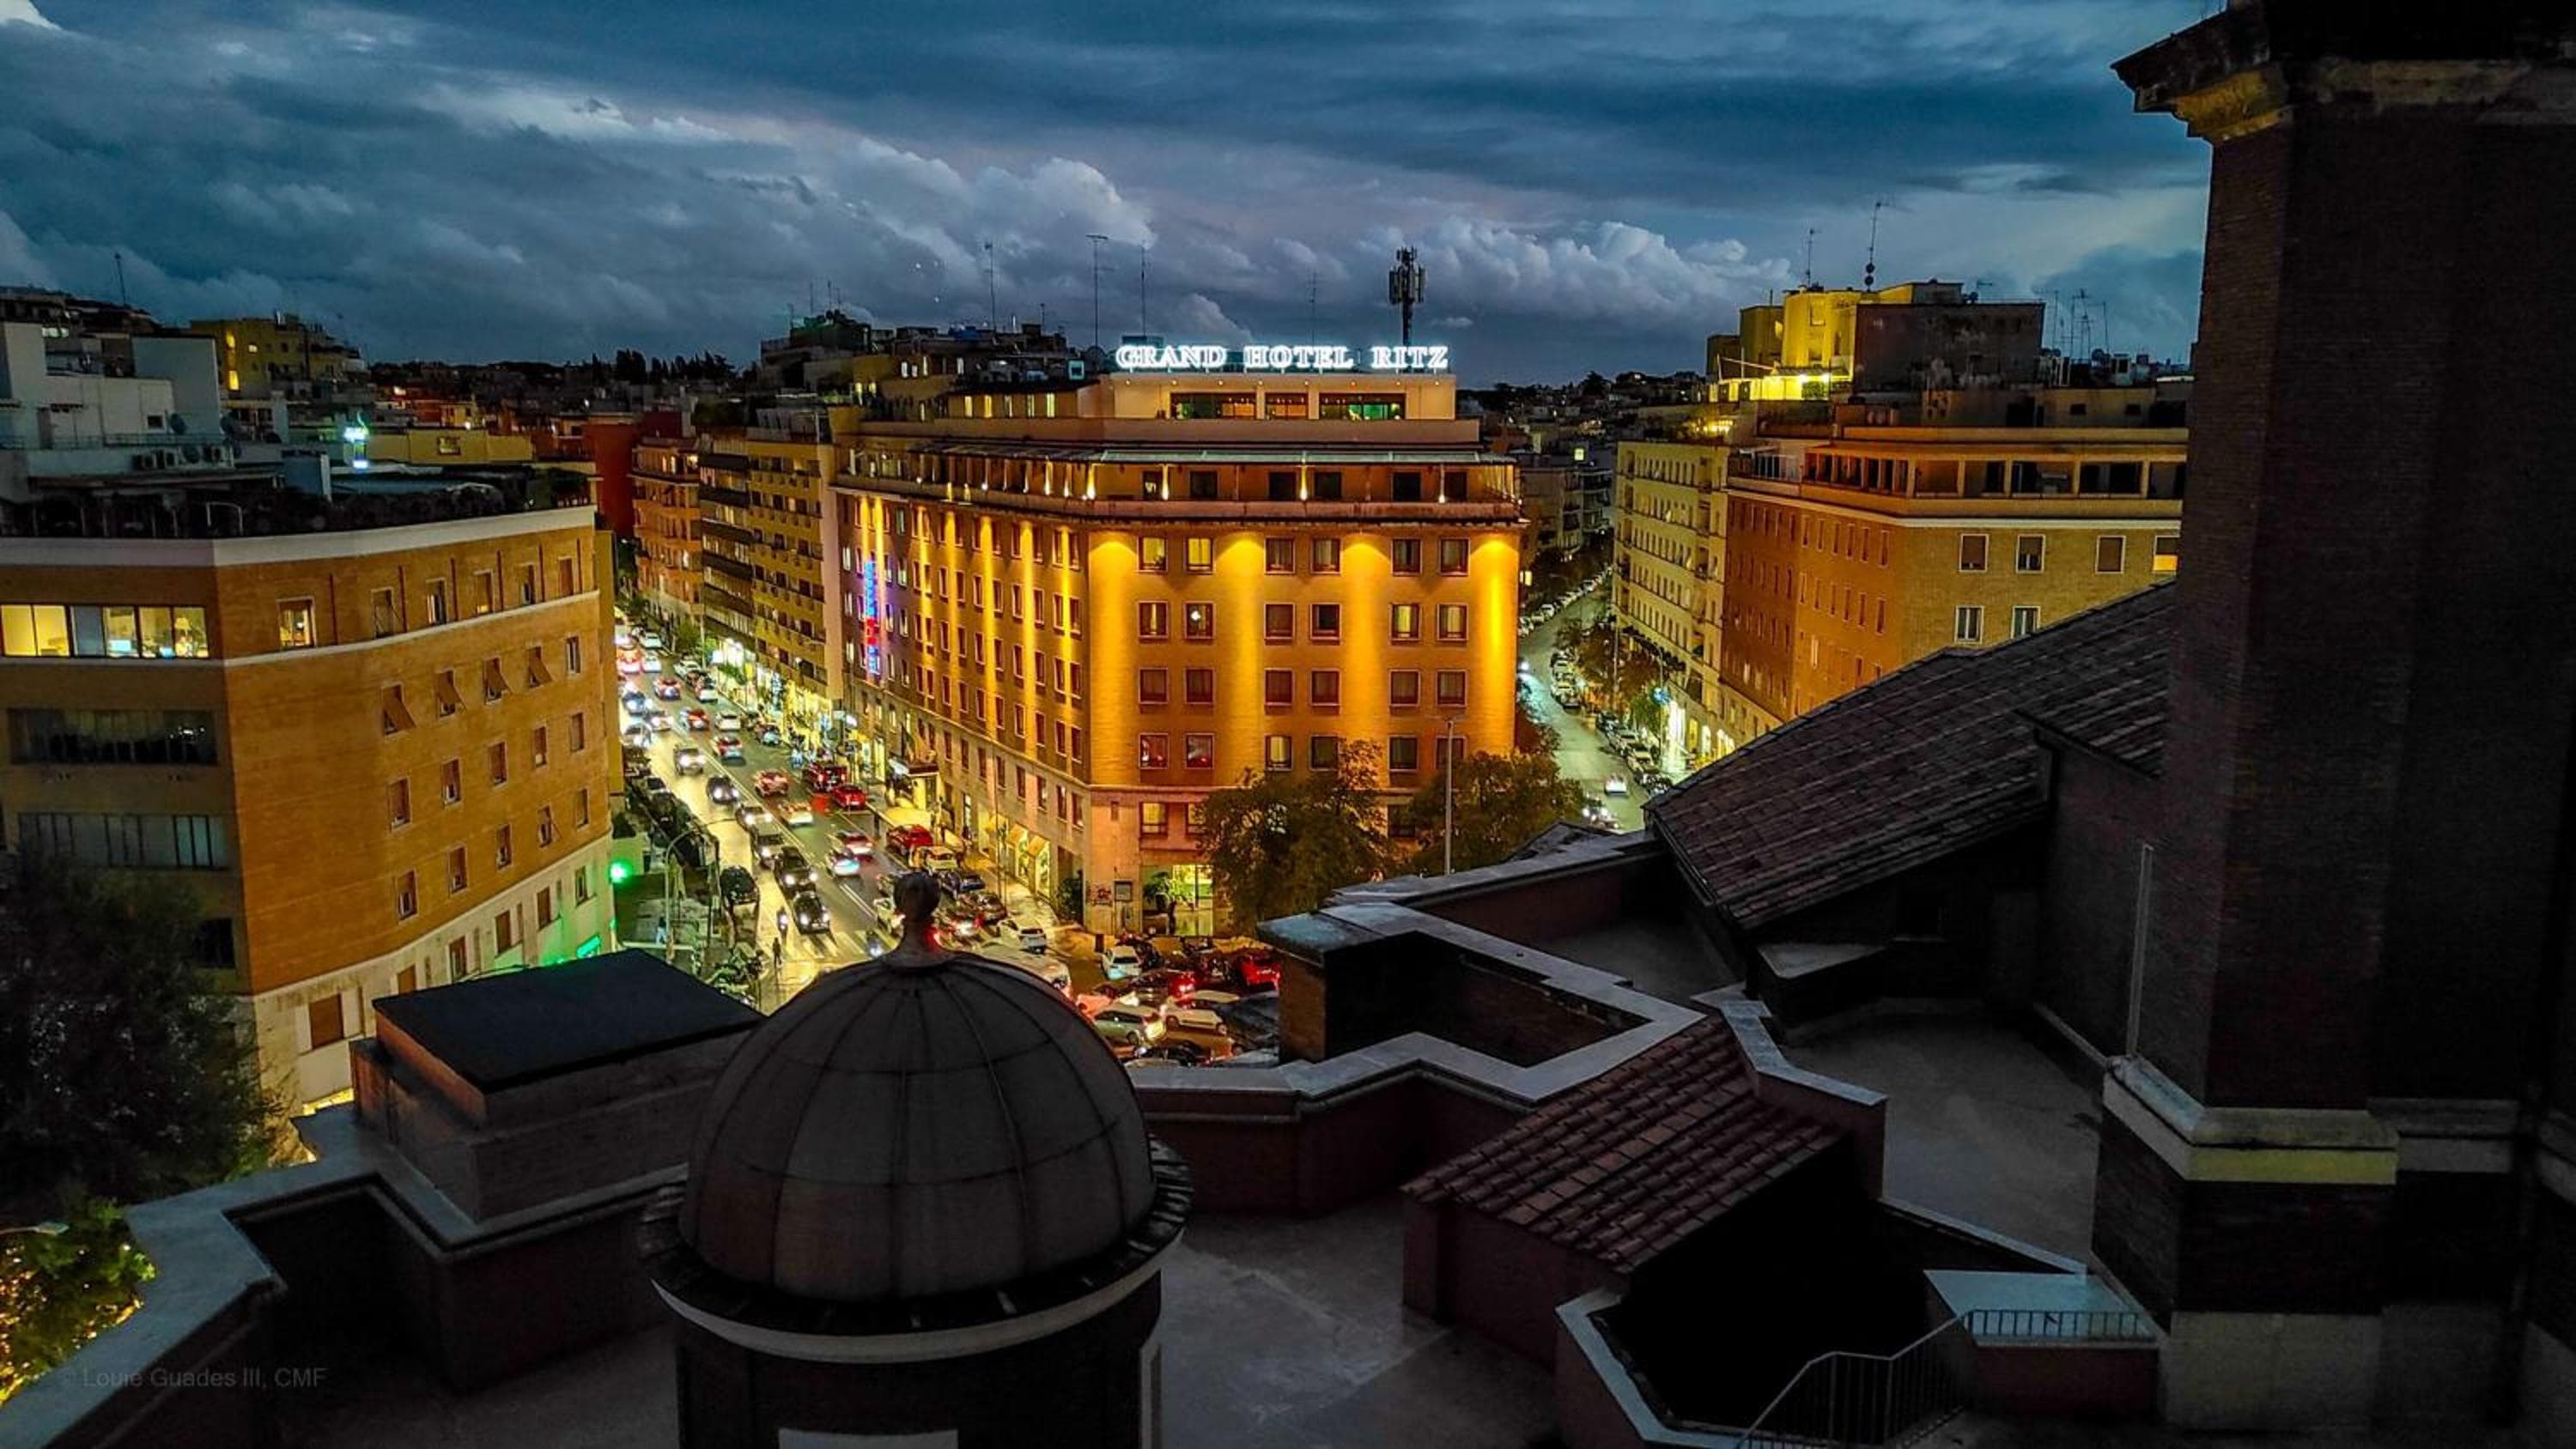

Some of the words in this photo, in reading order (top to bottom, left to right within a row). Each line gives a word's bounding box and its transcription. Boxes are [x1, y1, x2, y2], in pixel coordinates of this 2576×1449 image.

[1115, 344, 1227, 368] GRAND
[1242, 345, 1354, 368] HOTEL
[1371, 345, 1449, 368] RITZ
